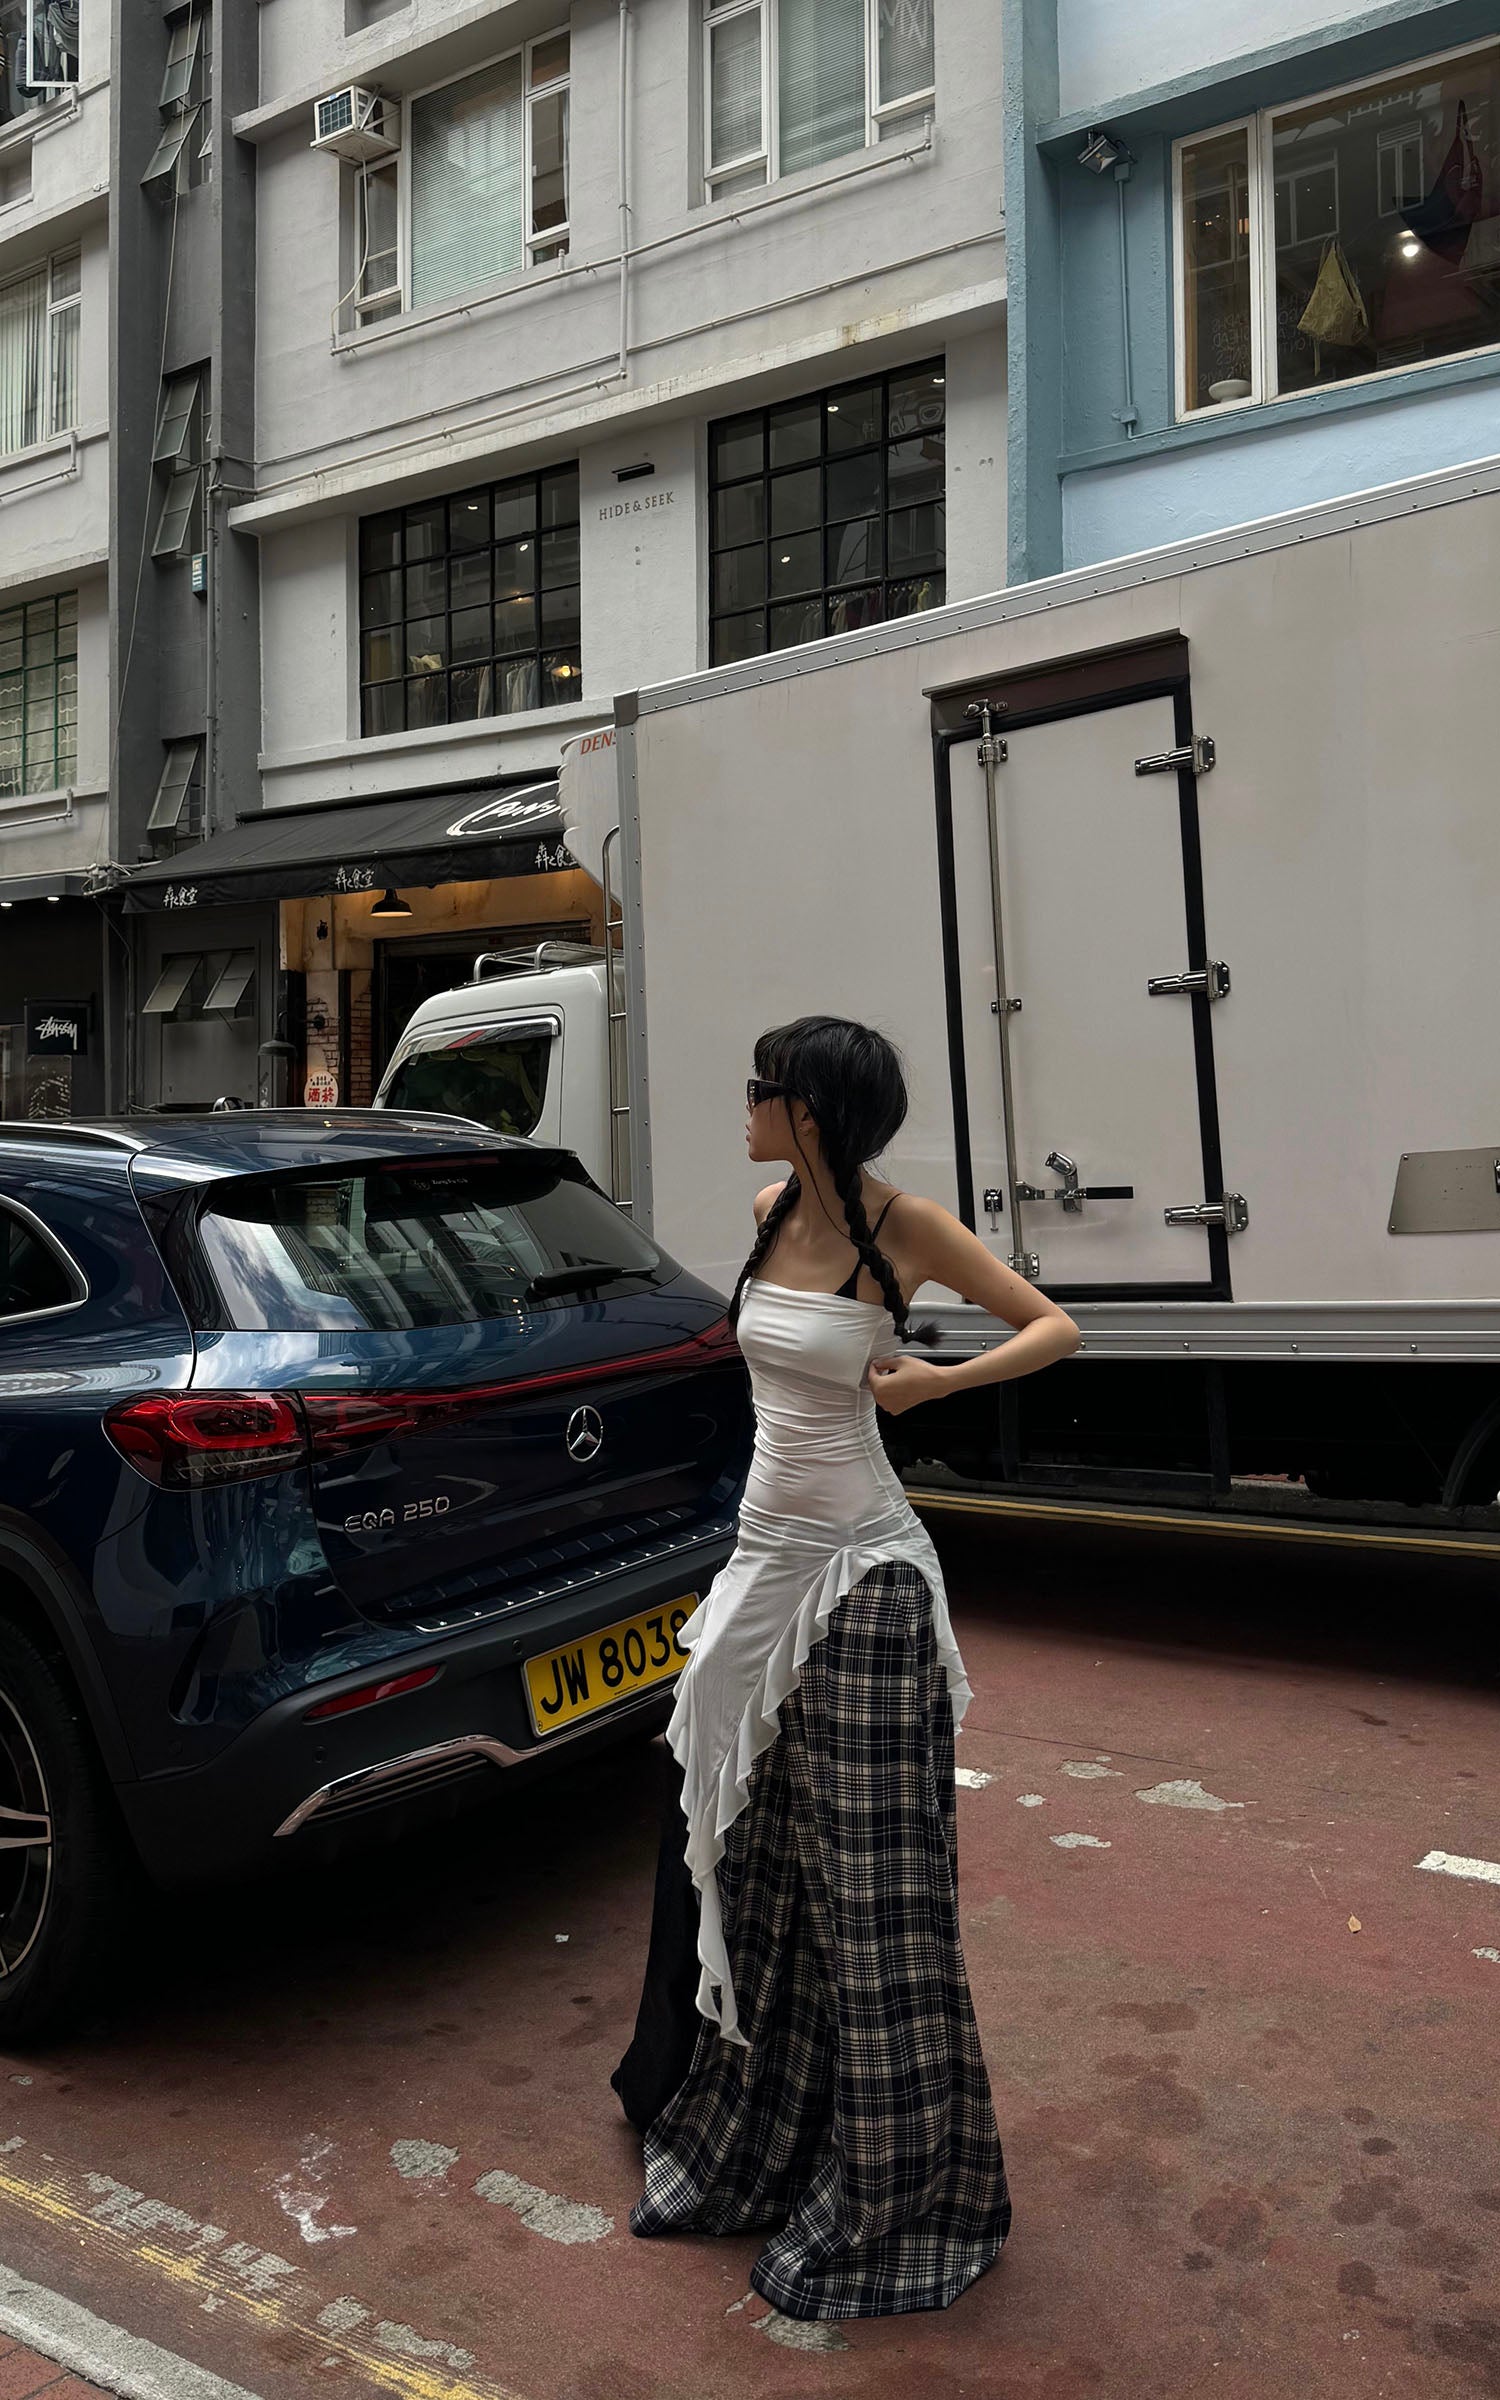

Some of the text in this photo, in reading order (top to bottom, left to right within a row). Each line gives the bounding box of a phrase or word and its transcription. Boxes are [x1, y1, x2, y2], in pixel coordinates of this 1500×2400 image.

[599, 491, 675, 521] HIDE & SEEK
[344, 1496, 450, 1533] EQA 250
[540, 1609, 692, 1714] JW 8038
